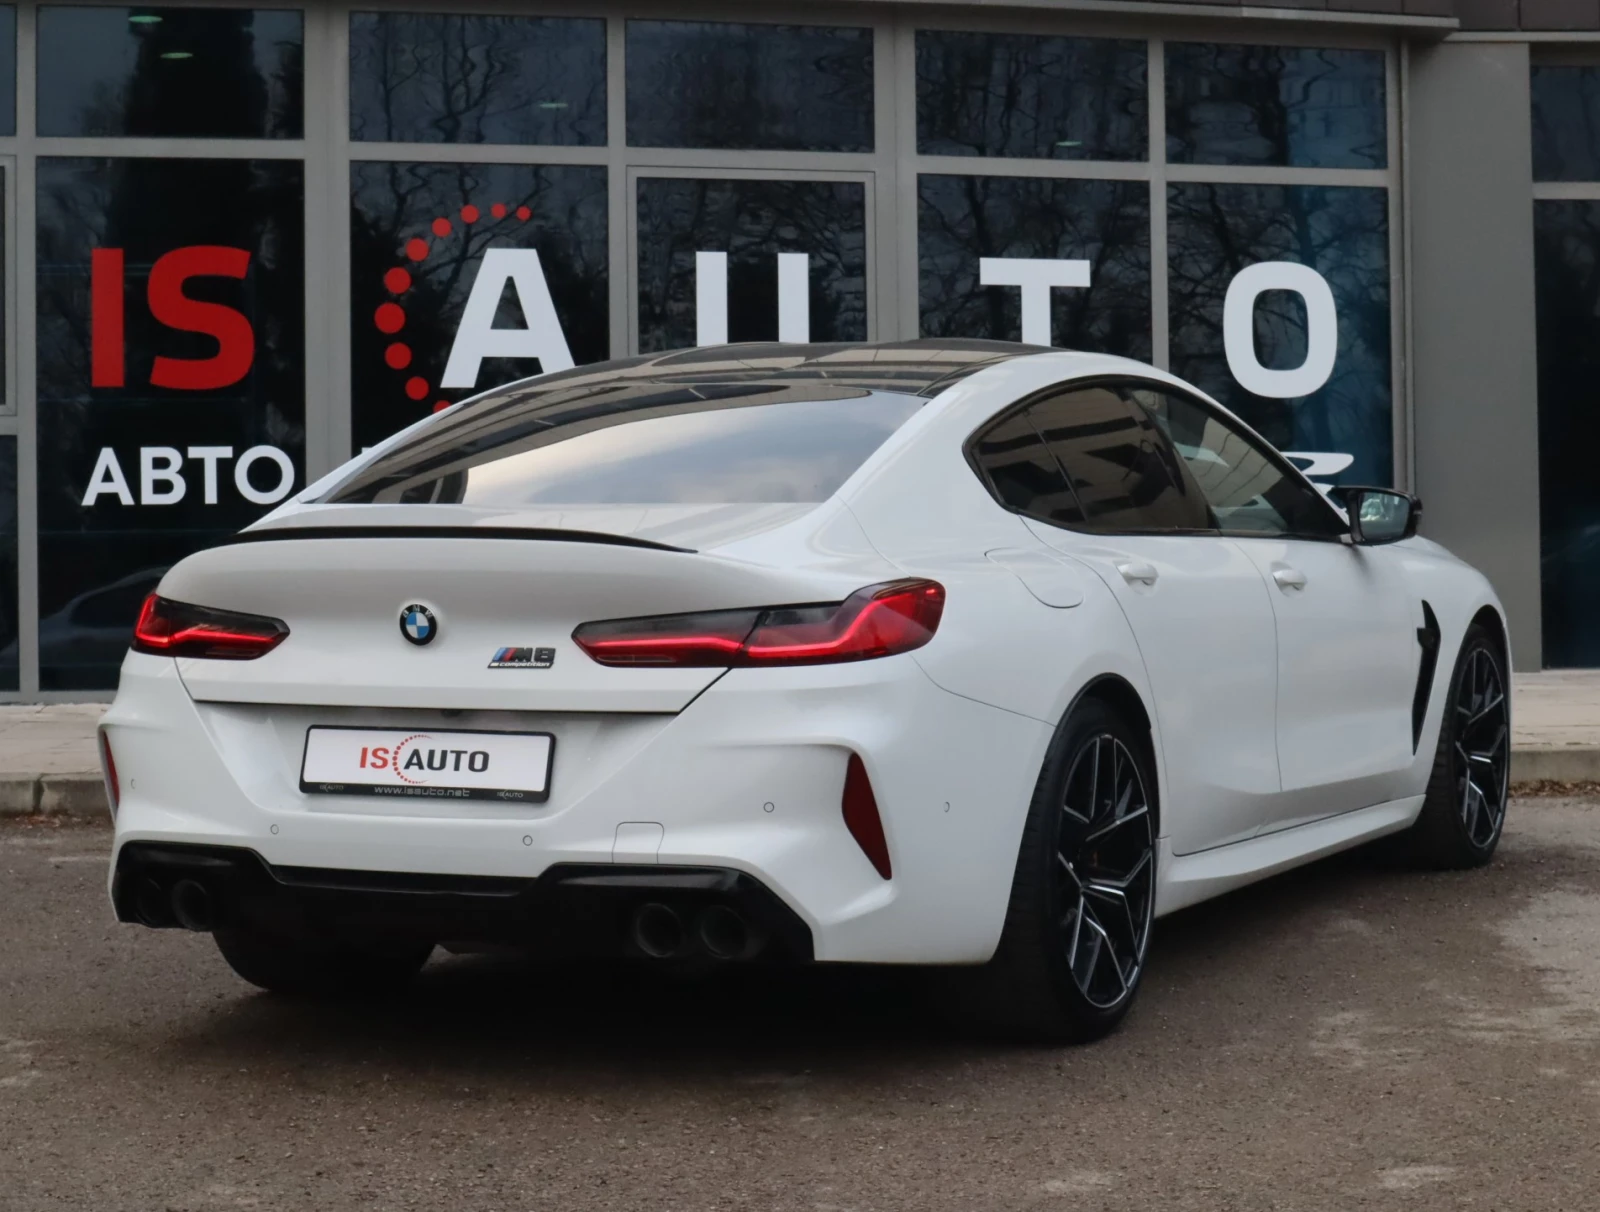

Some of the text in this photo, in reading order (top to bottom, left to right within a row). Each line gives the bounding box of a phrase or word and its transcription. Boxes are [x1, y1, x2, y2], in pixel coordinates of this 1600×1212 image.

[91, 245, 1338, 399] IS AUTO
[82, 446, 295, 506] АВТО
[402, 604, 433, 618] BMW
[359, 747, 490, 773] IS AUTO
[374, 786, 470, 797] www.isauto.net
